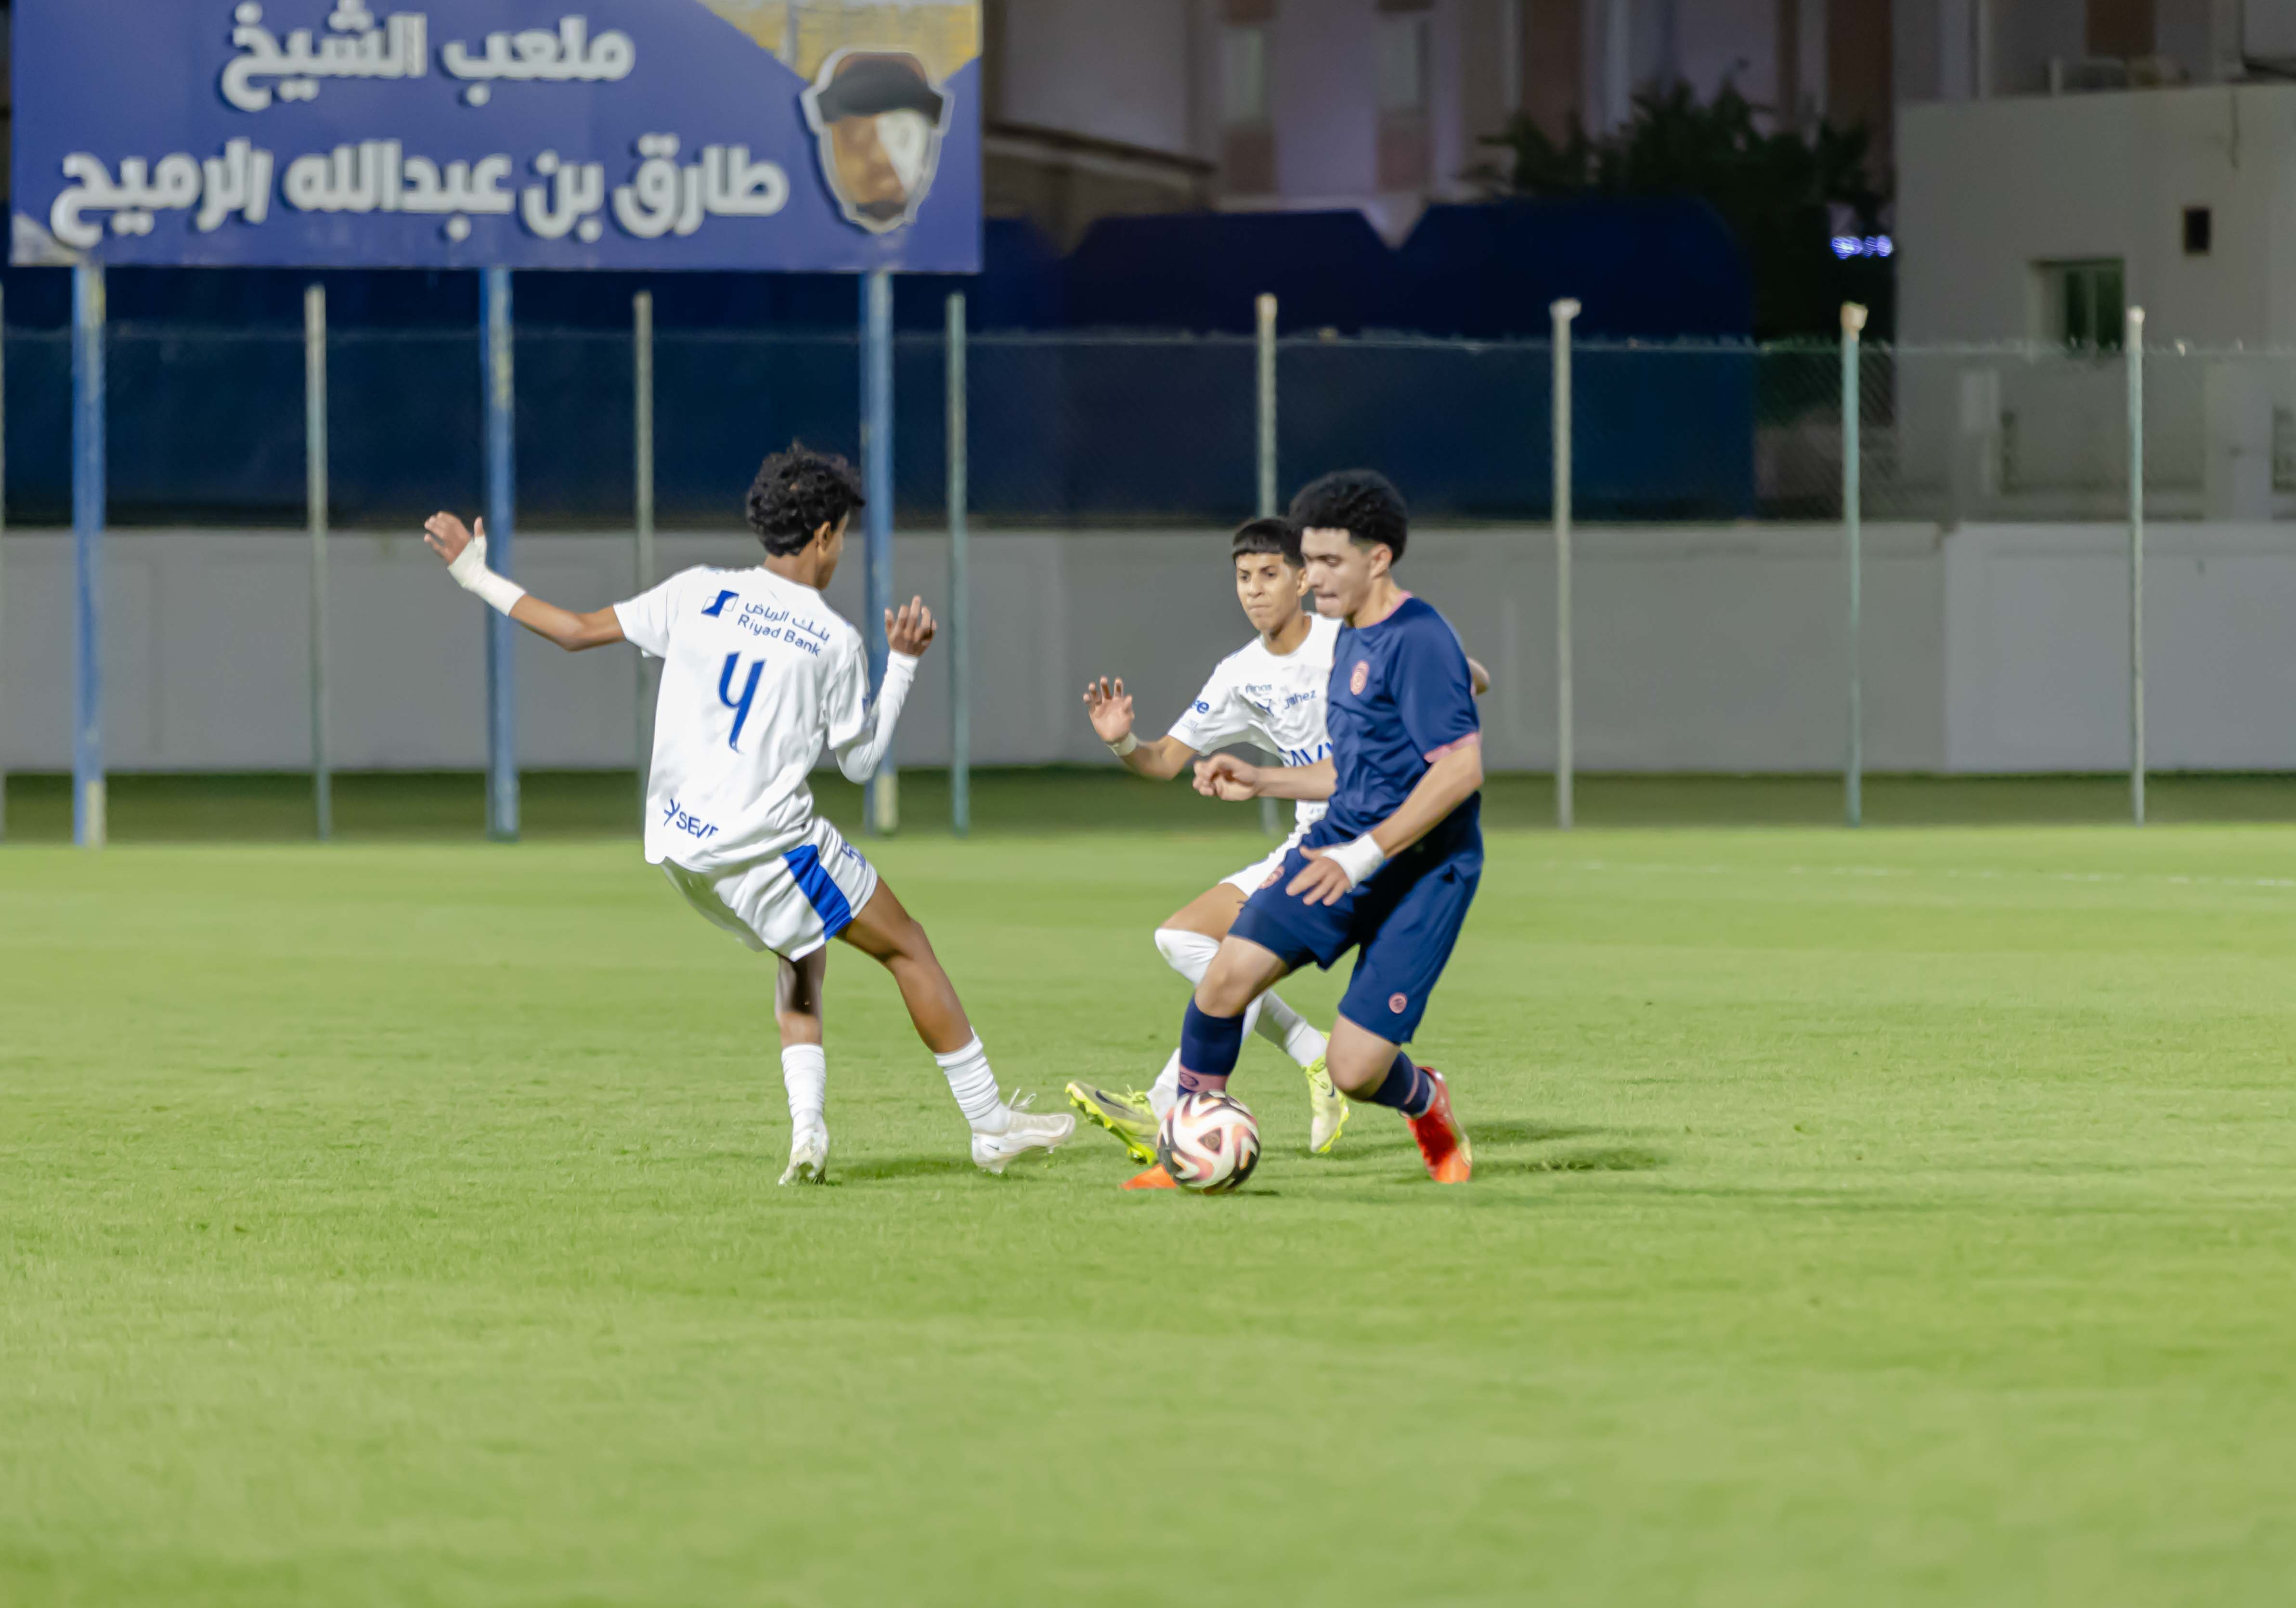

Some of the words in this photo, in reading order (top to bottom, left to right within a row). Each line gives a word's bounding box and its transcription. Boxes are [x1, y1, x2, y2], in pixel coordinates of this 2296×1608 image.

[222, 0, 428, 111] الشيخ
[443, 15, 636, 105] ملعب
[50, 138, 274, 248] الرميح
[523, 151, 604, 241] بن
[614, 134, 790, 237] طارق
[737, 613, 781, 638] Riyad
[783, 628, 821, 658] Bank
